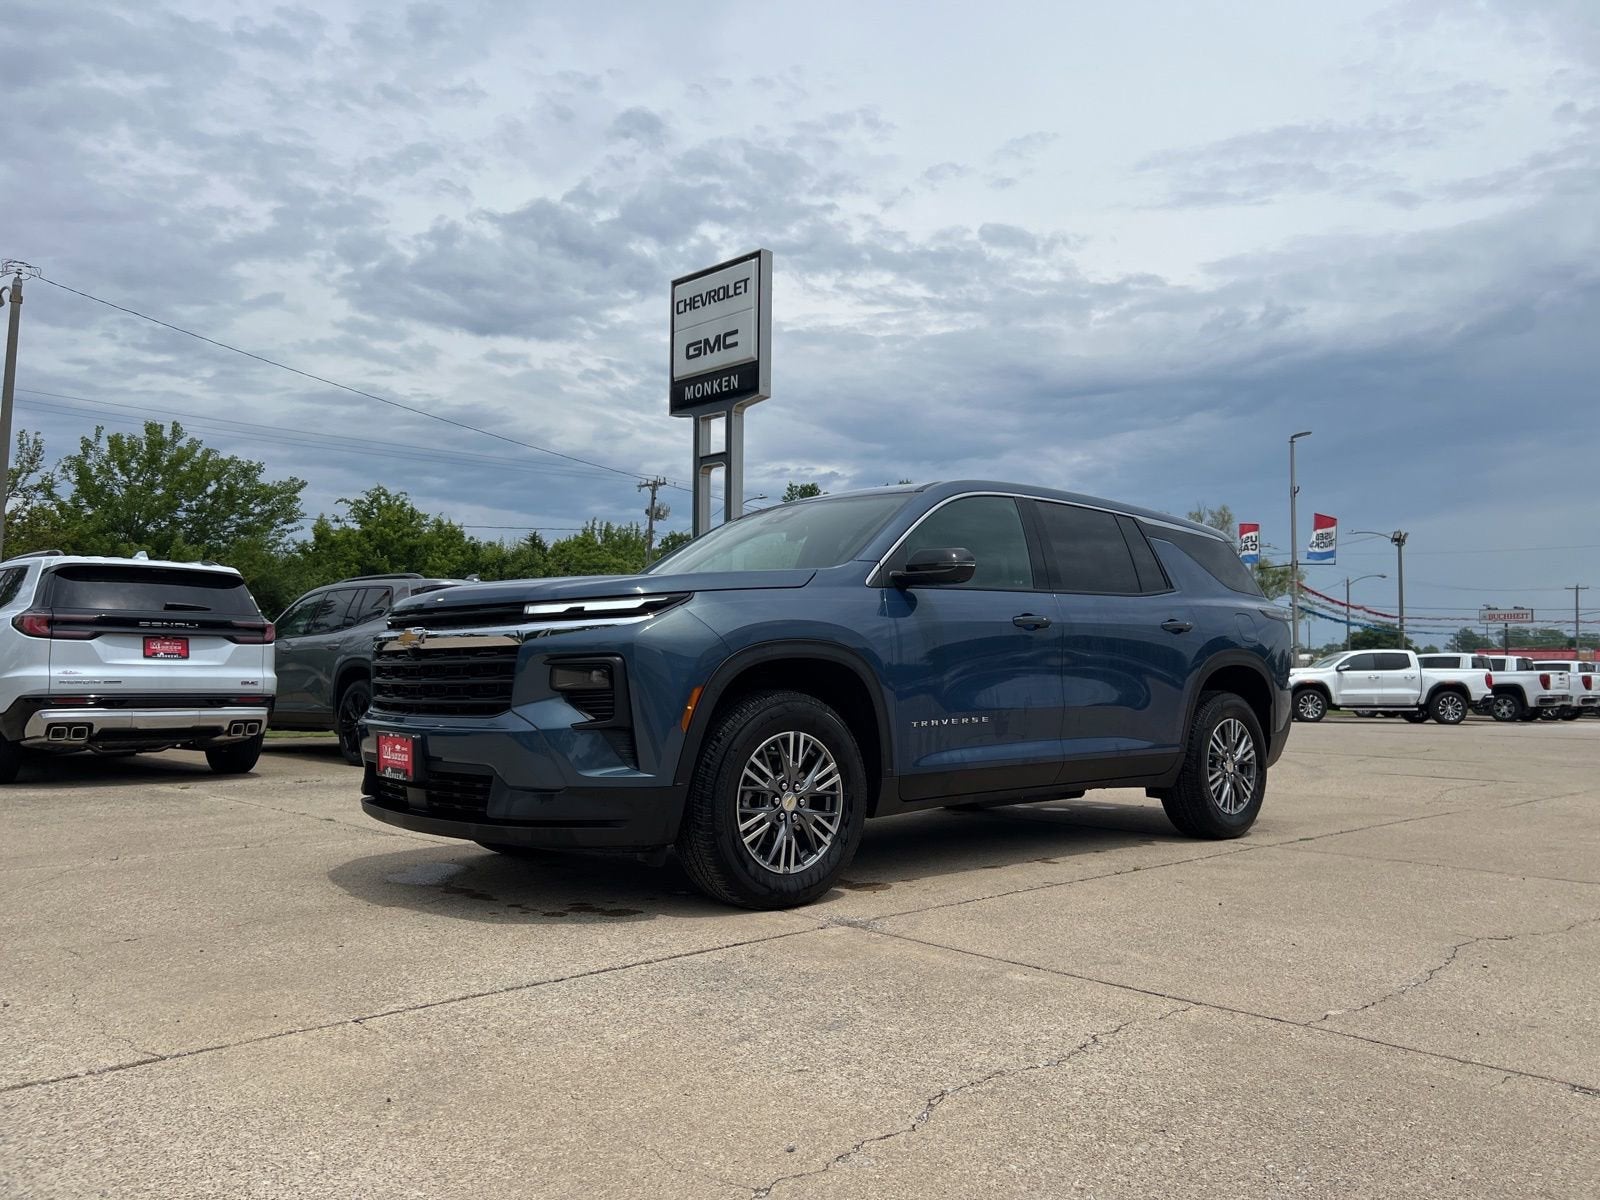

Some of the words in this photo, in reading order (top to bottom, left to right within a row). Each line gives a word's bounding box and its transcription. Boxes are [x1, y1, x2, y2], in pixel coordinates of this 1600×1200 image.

[676, 277, 750, 315] CHEVROLET
[685, 329, 739, 361] GMC
[684, 374, 739, 400] MONKEN
[911, 716, 989, 728] TRAVERSE
